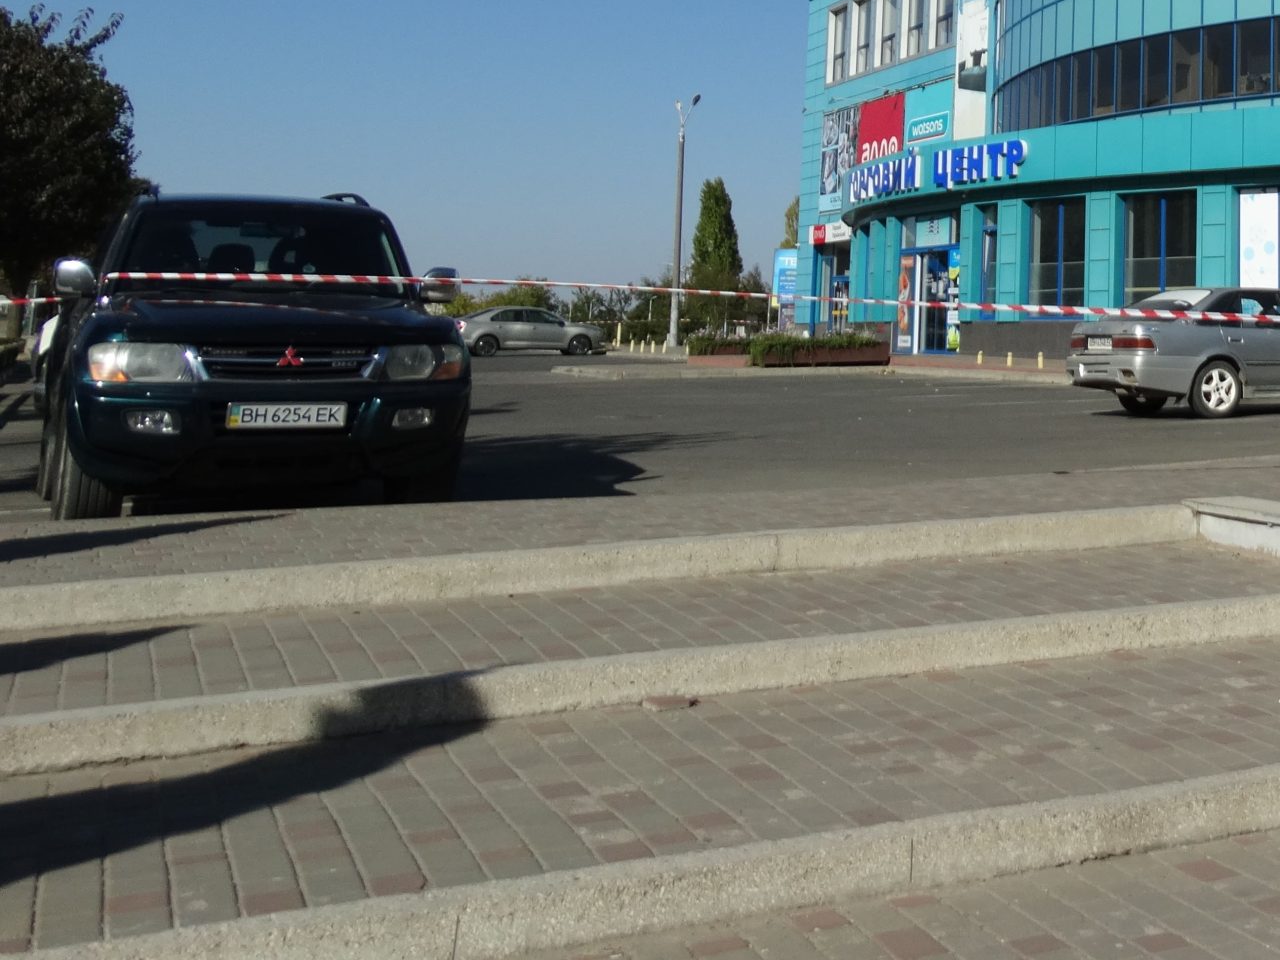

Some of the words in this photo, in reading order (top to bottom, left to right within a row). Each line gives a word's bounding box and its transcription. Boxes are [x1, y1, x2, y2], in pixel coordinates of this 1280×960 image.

[911, 117, 943, 137] watsons
[933, 140, 1026, 191] ЦЕНТР
[240, 407, 268, 424] BH
[271, 407, 312, 424] 6254
[315, 407, 342, 423] EK
